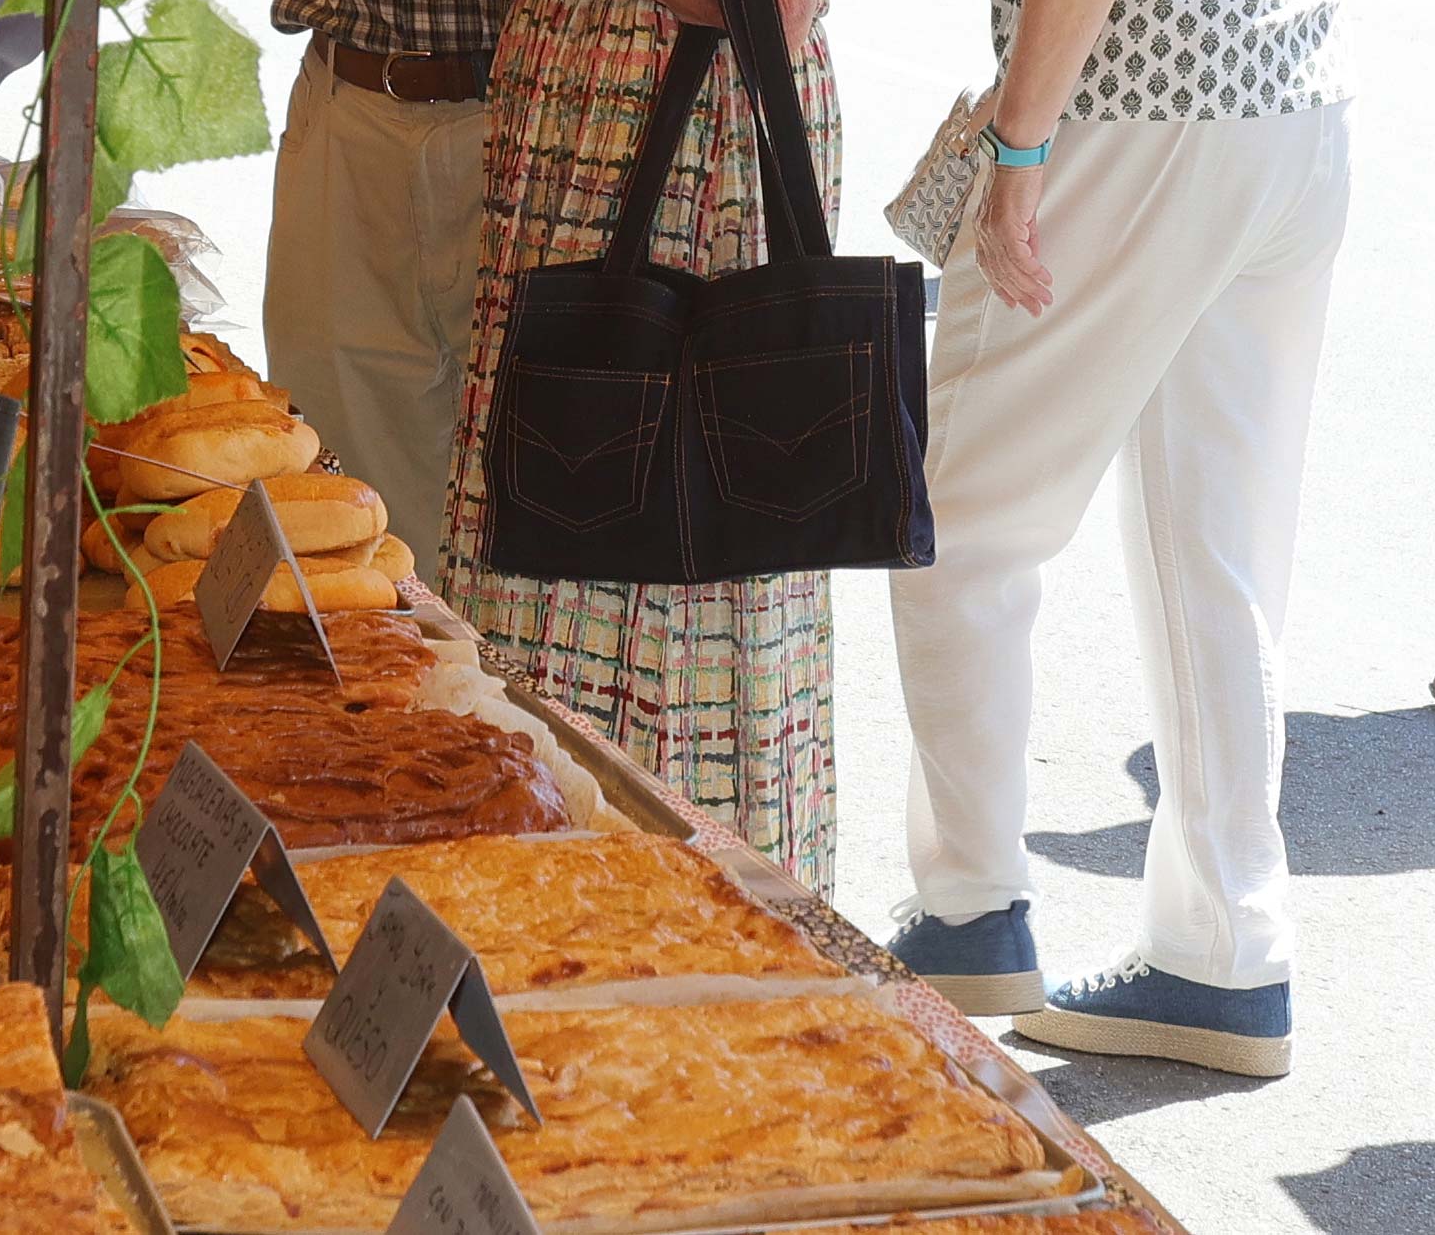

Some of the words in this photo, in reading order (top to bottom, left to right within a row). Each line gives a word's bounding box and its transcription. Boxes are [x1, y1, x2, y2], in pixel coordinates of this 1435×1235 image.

[156, 798, 214, 869] CHOCOLATE
[172, 751, 242, 838] MAGDALENAS
[232, 820, 253, 853] DE
[324, 992, 387, 1083] QUESO
